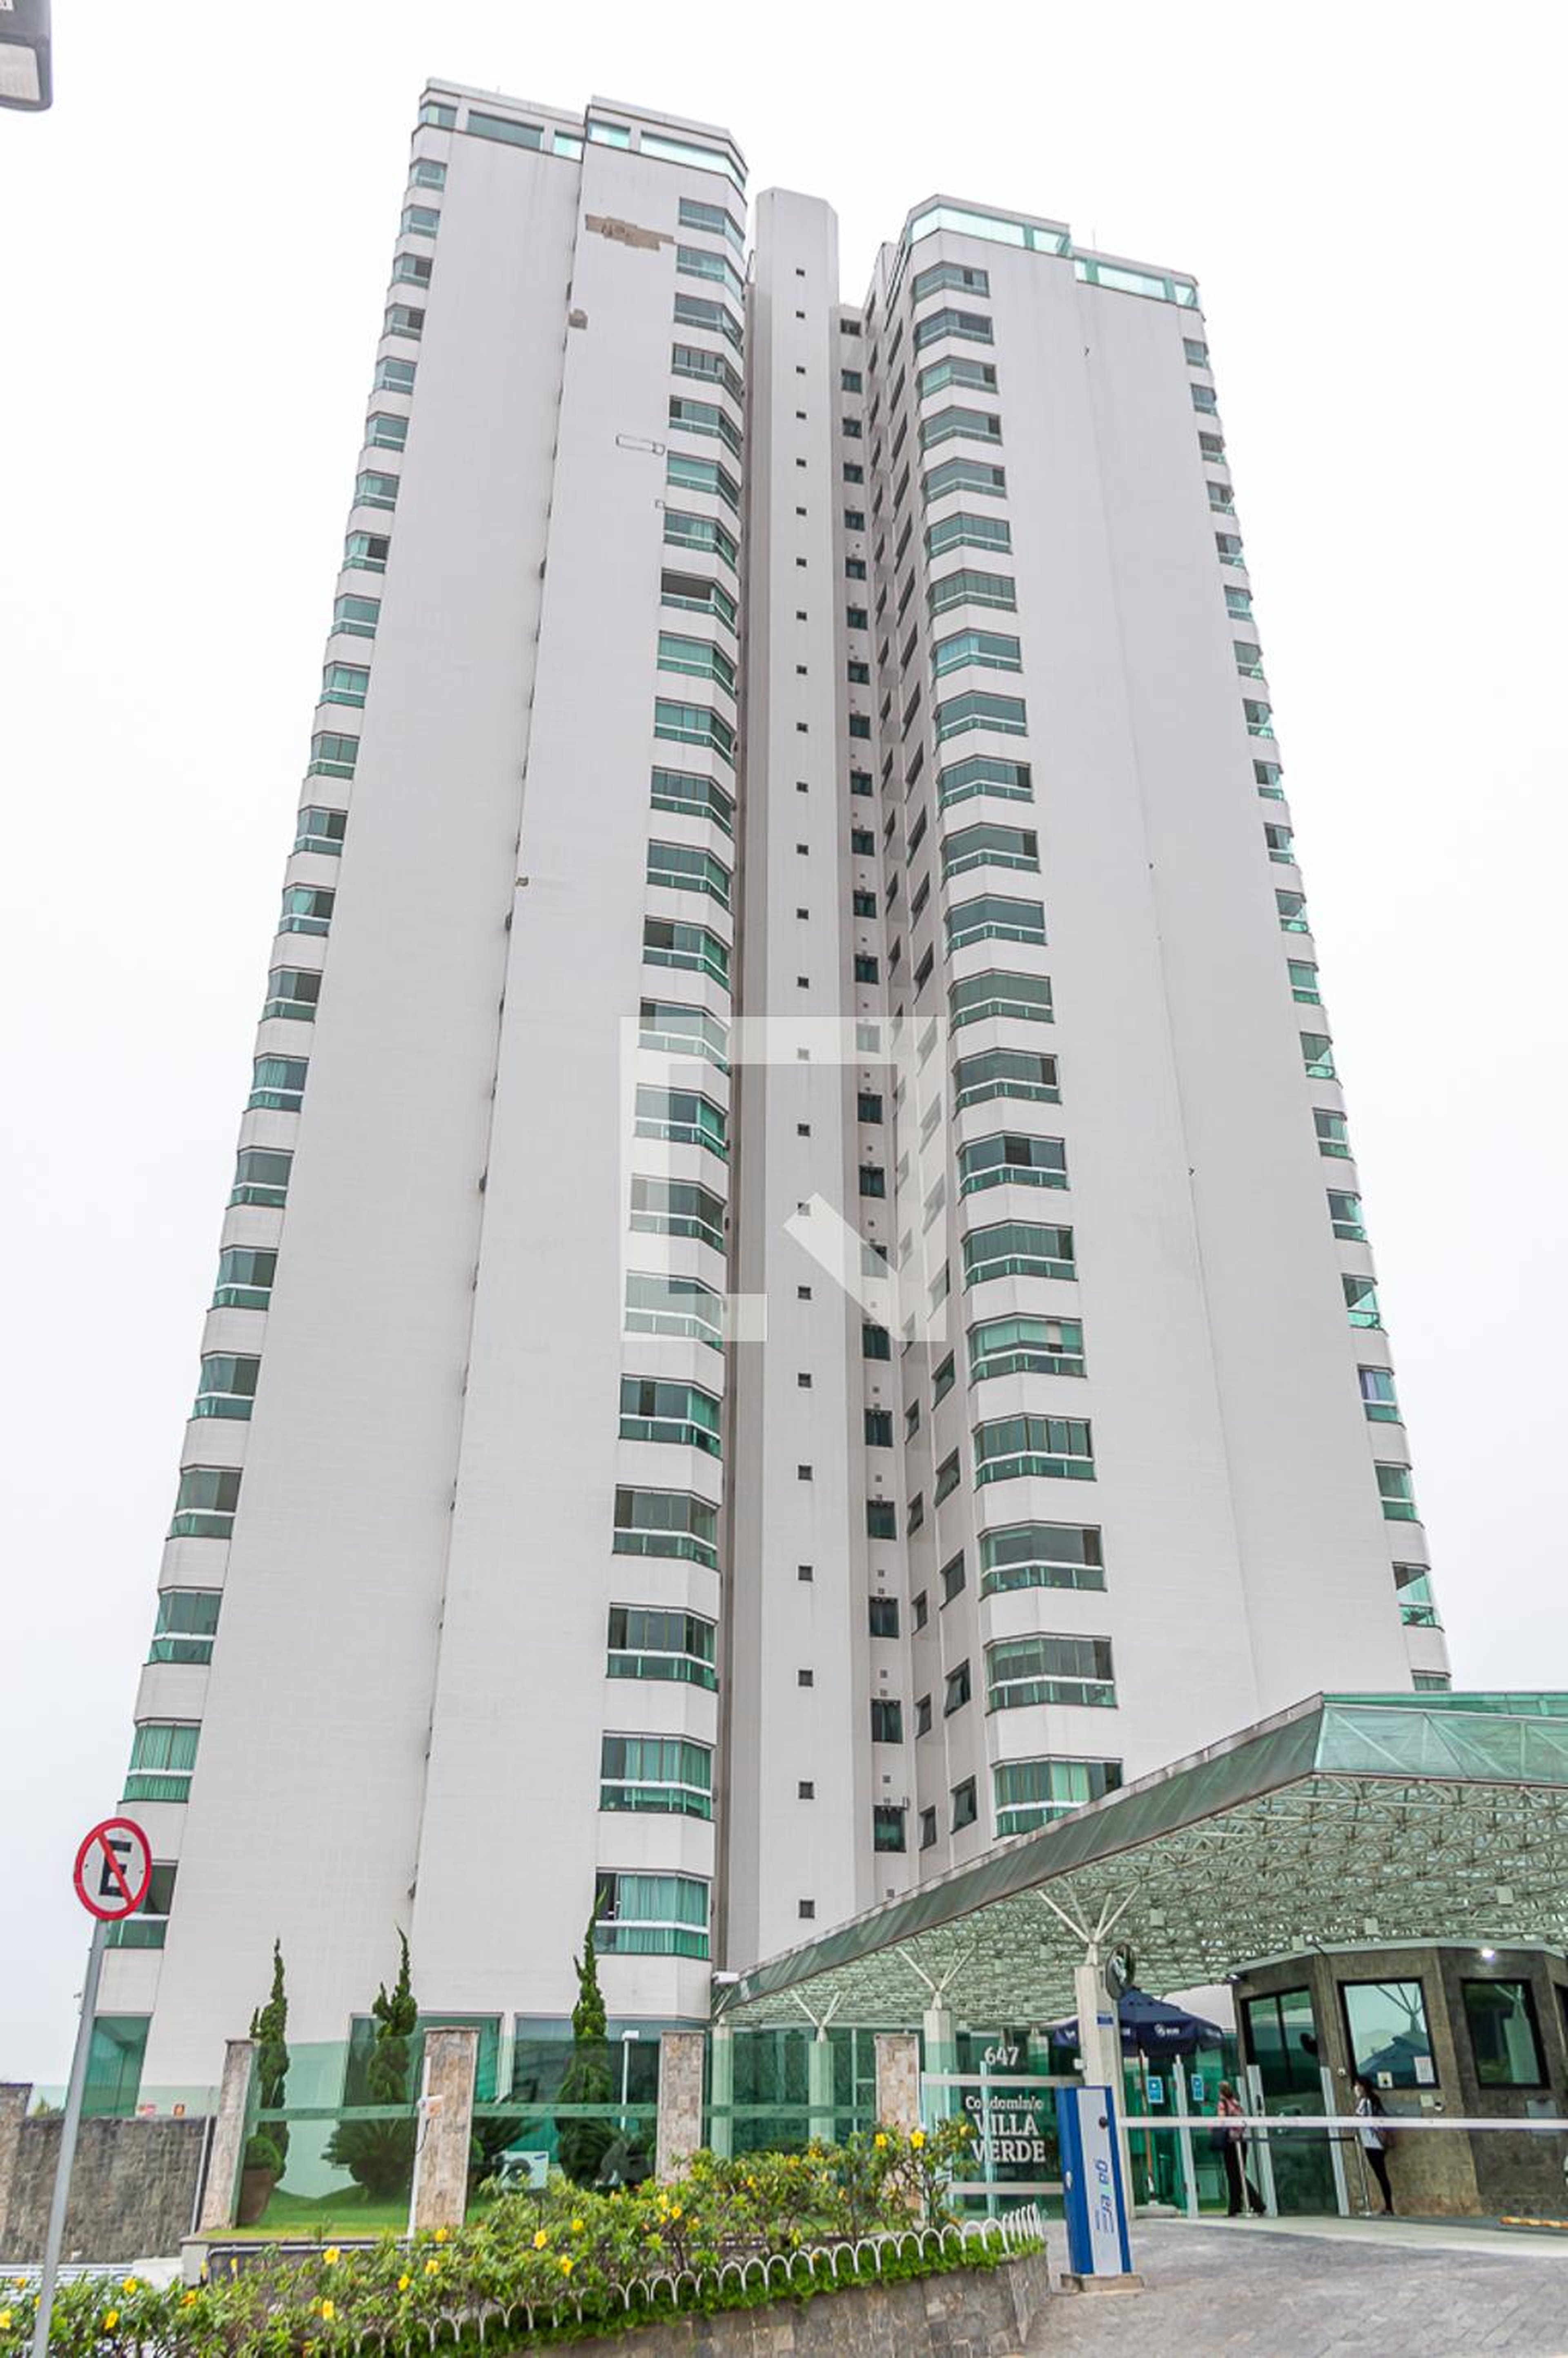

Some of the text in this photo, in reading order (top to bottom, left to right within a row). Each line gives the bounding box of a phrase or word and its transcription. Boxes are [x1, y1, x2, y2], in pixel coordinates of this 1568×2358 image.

[984, 2046, 1019, 2066] 647
[973, 2114, 1039, 2136] VILLA
[970, 2140, 1046, 2162] VERDE
